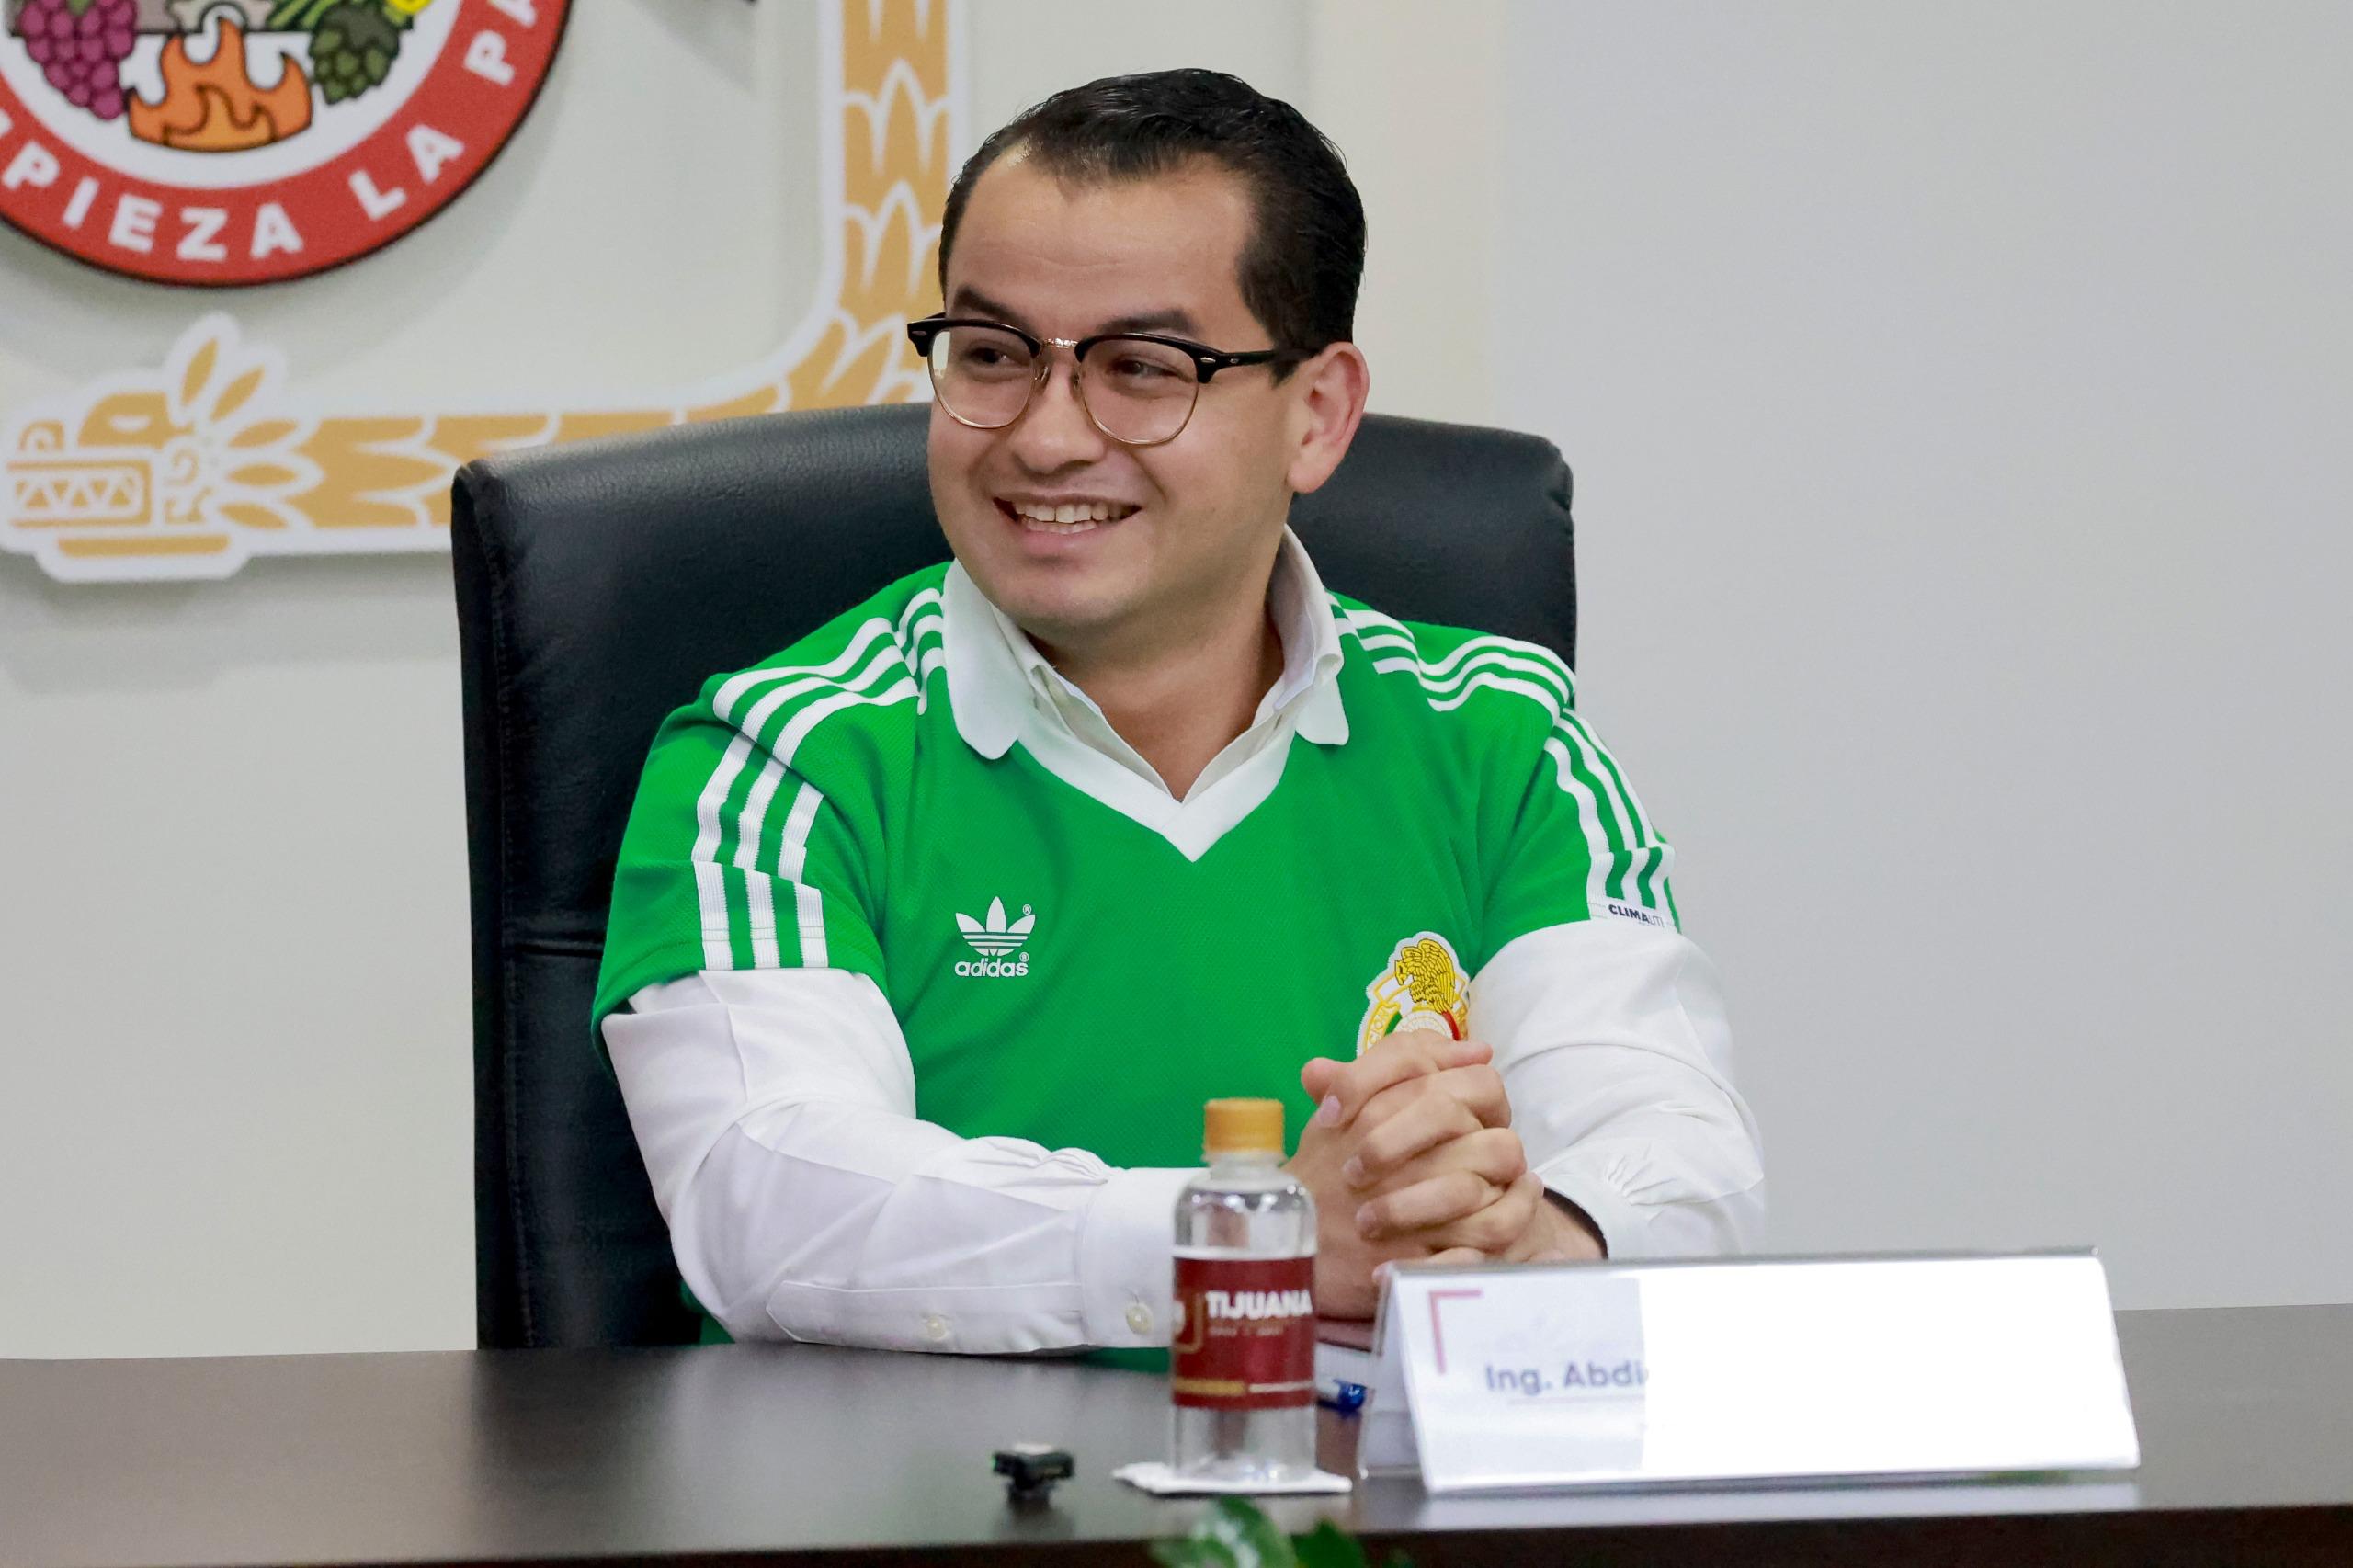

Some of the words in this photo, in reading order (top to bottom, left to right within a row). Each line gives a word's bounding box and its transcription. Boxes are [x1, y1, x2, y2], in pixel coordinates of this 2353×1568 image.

[0, 108, 304, 262] PIEZA
[348, 124, 465, 221] LA
[954, 957, 1029, 977] adidas
[1205, 1289, 1313, 1320] TIJUANA
[1484, 1365, 1554, 1396] Ing.
[1563, 1359, 1649, 1388] Abdi
